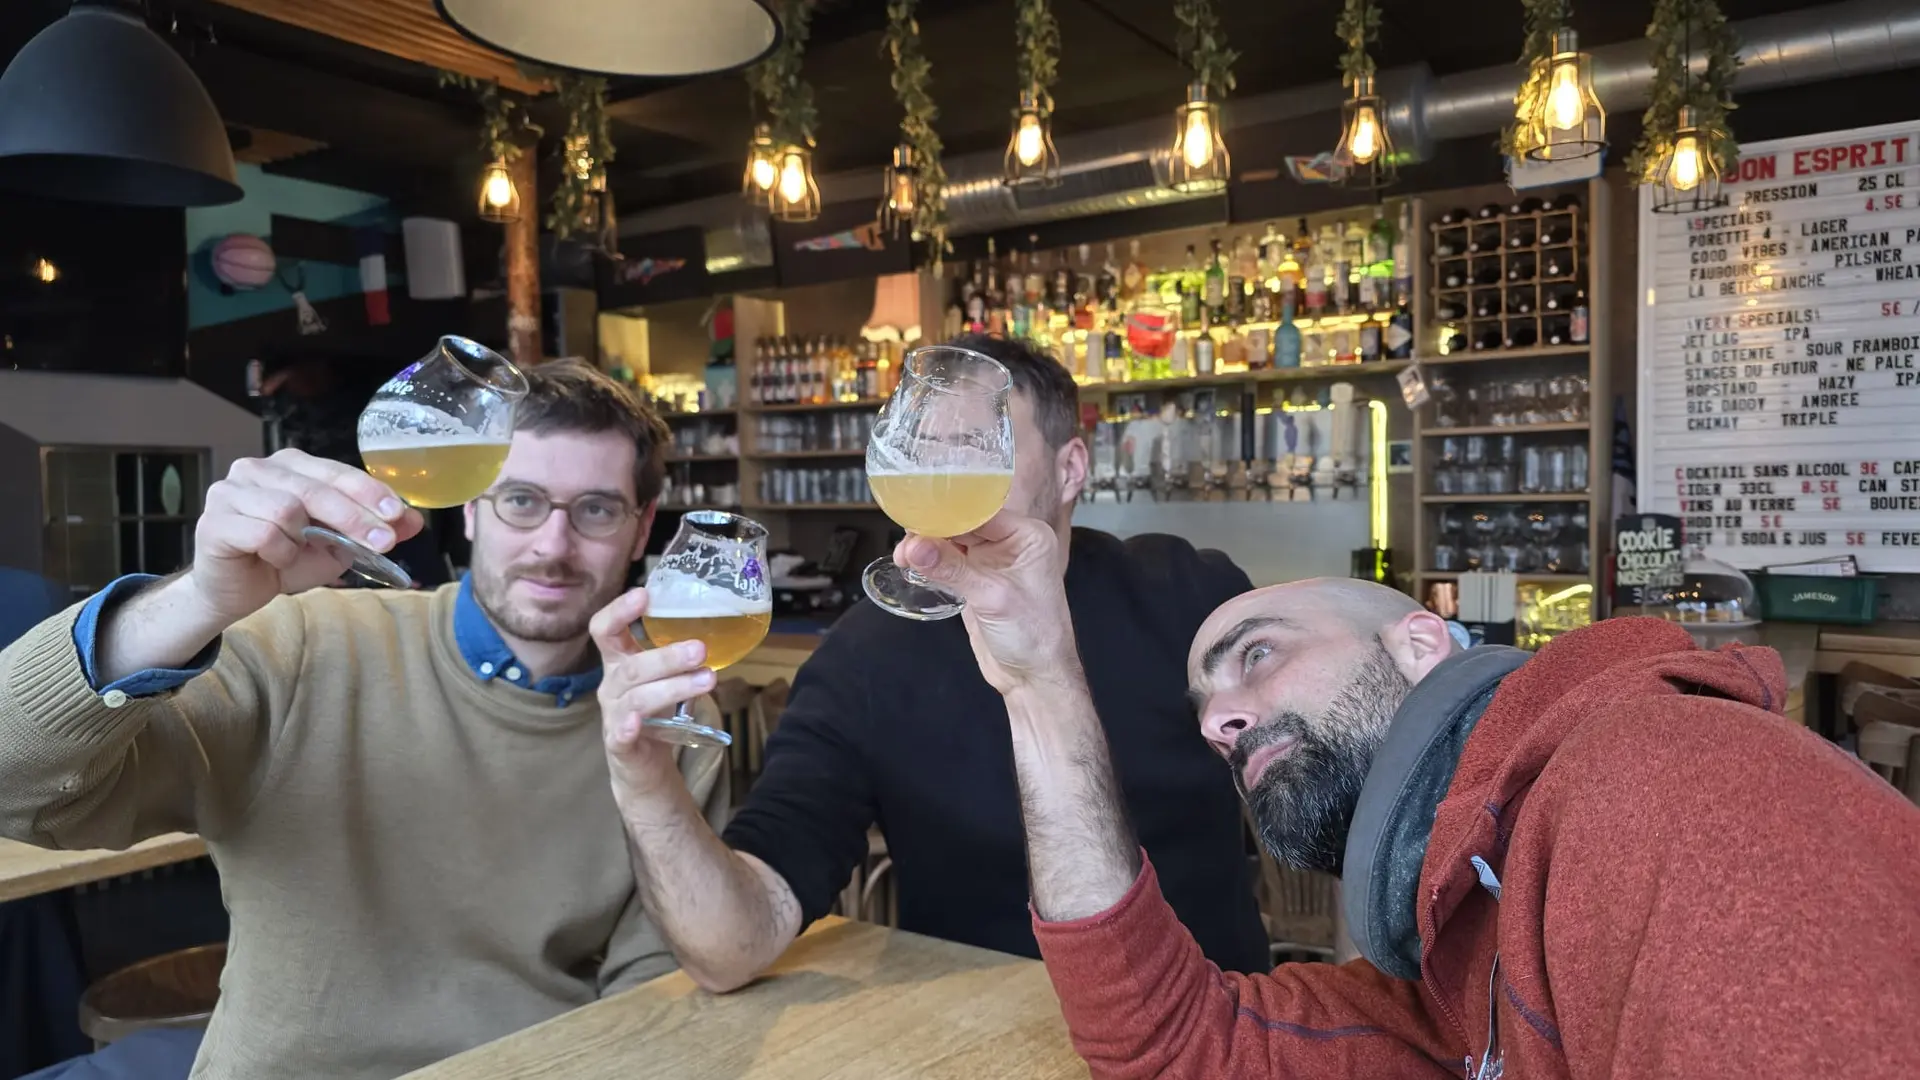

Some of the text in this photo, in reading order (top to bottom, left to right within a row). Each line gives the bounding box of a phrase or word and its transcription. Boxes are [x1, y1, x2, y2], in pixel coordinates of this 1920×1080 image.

[1794, 138, 1909, 176] ESPRIT
[1744, 183, 1818, 205] PRESSION
[1859, 176, 1877, 191] 25
[1886, 174, 1904, 188] CL
[1689, 230, 1749, 248] PORETTI
[1764, 227, 1771, 240] 4
[1802, 219, 1848, 237] LAGER
[1691, 249, 1727, 264] GOOD
[1742, 242, 1787, 258] VIBES
[1811, 232, 1889, 253] AMERICAN
[1835, 248, 1902, 268] PILSNER
[1689, 284, 1704, 298] LA
[1681, 334, 1705, 349] JET
[1713, 332, 1739, 346] LAG
[1784, 326, 1810, 341] IPA
[1685, 350, 1702, 365] LA
[1712, 346, 1775, 363] DETENTE
[1806, 341, 1843, 357] SOUR
[1685, 366, 1737, 381] SINGES
[1744, 364, 1762, 378] DU
[1772, 360, 1818, 376] FUTUR
[1846, 356, 1865, 372] NE
[1875, 353, 1914, 370] PALE
[1818, 375, 1855, 391] HAZY
[1687, 400, 1713, 414] BIG
[1722, 397, 1766, 413] DADDY
[1801, 392, 1859, 408] AMBREE
[1687, 416, 1739, 431] CHIMAY
[1781, 411, 1838, 427] TRIPLE
[1675, 465, 1746, 480] COCKTAIL
[1754, 464, 1789, 478] SANS
[1796, 462, 1850, 477] ALCOOL
[1677, 483, 1721, 496] CIDER
[1859, 479, 1887, 493] CAN
[1680, 499, 1713, 512] VINS
[1724, 499, 1742, 511] AU
[1750, 498, 1795, 511] VERRE
[1618, 526, 1675, 553] COOKIE
[1741, 532, 1776, 545] SODA
[1798, 532, 1826, 546] JUS
[1616, 550, 1681, 571] CHOCOLAT
[1792, 591, 1836, 603] JAMESON
